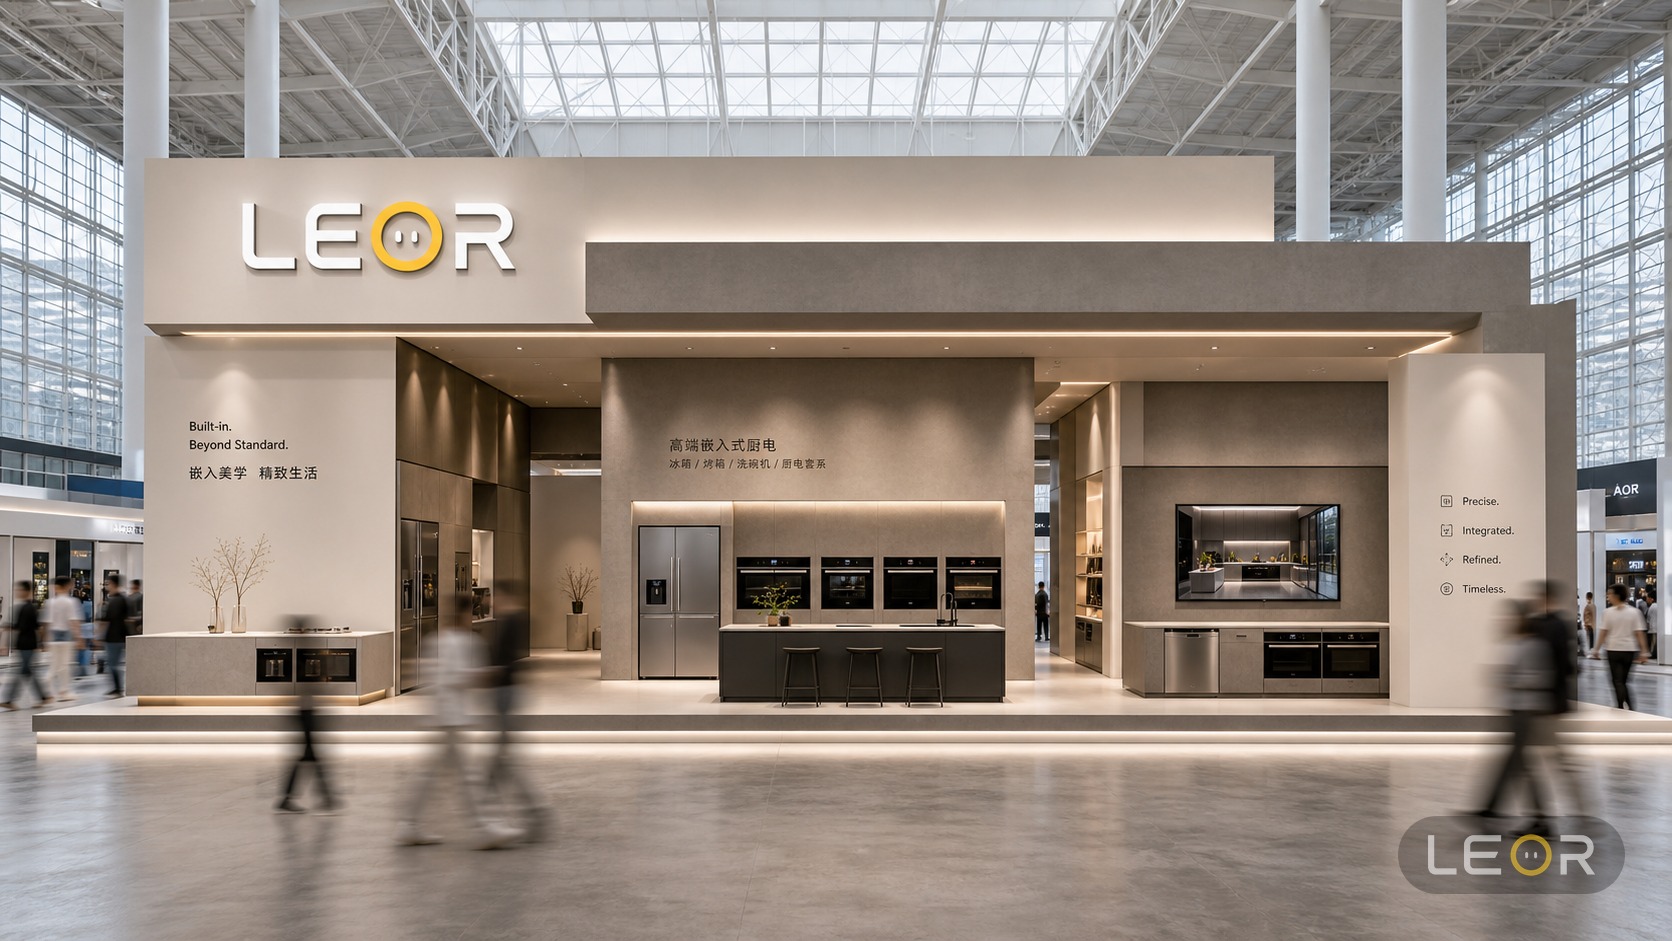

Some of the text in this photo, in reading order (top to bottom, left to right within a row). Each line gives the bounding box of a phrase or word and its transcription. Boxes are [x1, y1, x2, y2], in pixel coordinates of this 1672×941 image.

[242, 201, 516, 272] LEOR
[189, 421, 232, 432] Built-in.
[189, 439, 289, 452] Beyond Standard.
[669, 438, 777, 452] 高端嵌入式厨电
[189, 466, 318, 480] 嵌入美学 精致生活
[1613, 484, 1639, 496] AOR
[1462, 496, 1499, 506] Precise.
[1462, 525, 1515, 538] Integrated.
[1462, 554, 1501, 564] Refined.
[1462, 584, 1506, 594] Timeless.
